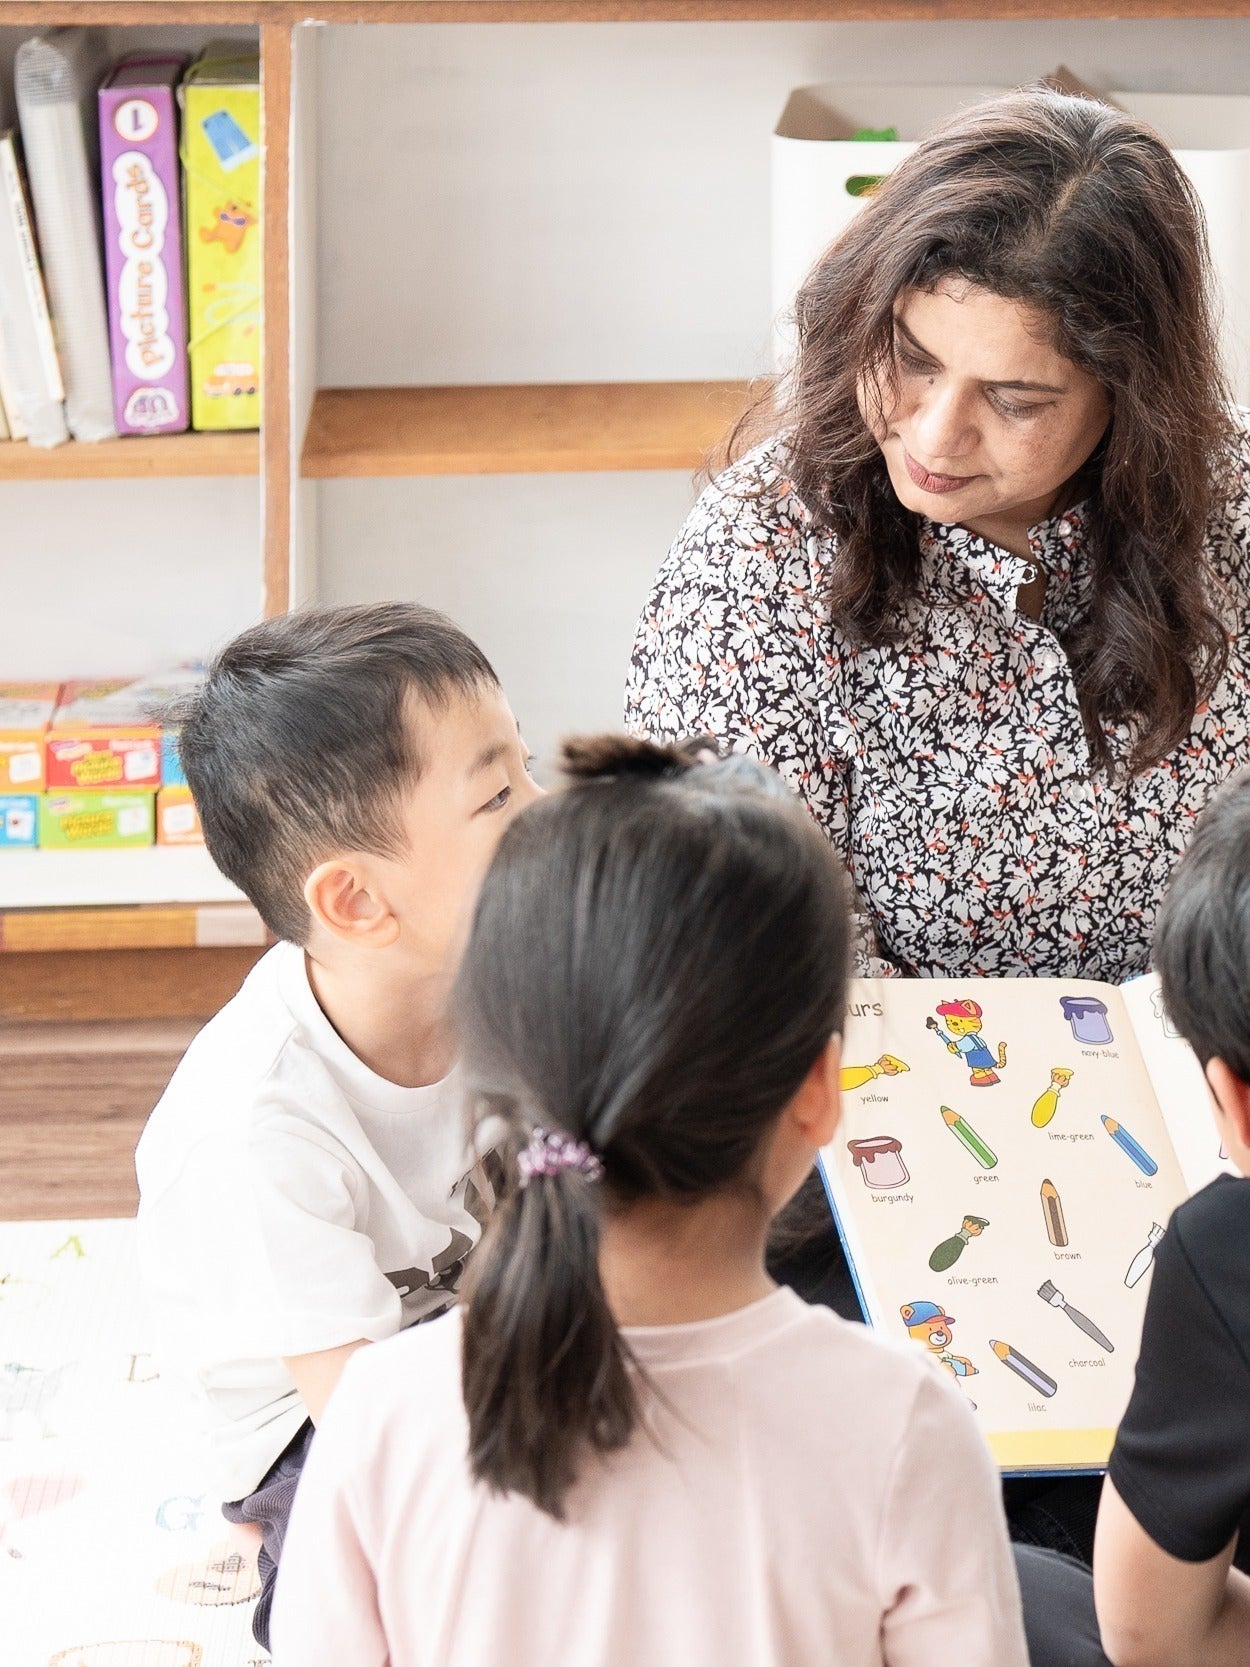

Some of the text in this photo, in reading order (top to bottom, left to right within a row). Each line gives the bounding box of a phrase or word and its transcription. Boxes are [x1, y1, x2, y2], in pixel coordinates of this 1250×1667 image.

[126, 164, 153, 249] Cards
[130, 262, 165, 367] Picture
[848, 1002, 884, 1017] urs
[1081, 1049, 1120, 1060] navy-blue
[859, 1093, 889, 1105] yellow
[1047, 1131, 1095, 1143] lime-green
[973, 1174, 1000, 1185] green
[1134, 1180, 1153, 1190] blue
[870, 1193, 914, 1205] burgundy
[1053, 1250, 1082, 1261] brown
[946, 1275, 999, 1287] olive-green
[1068, 1357, 1106, 1368] charcoal
[1027, 1402, 1048, 1412] lilac
